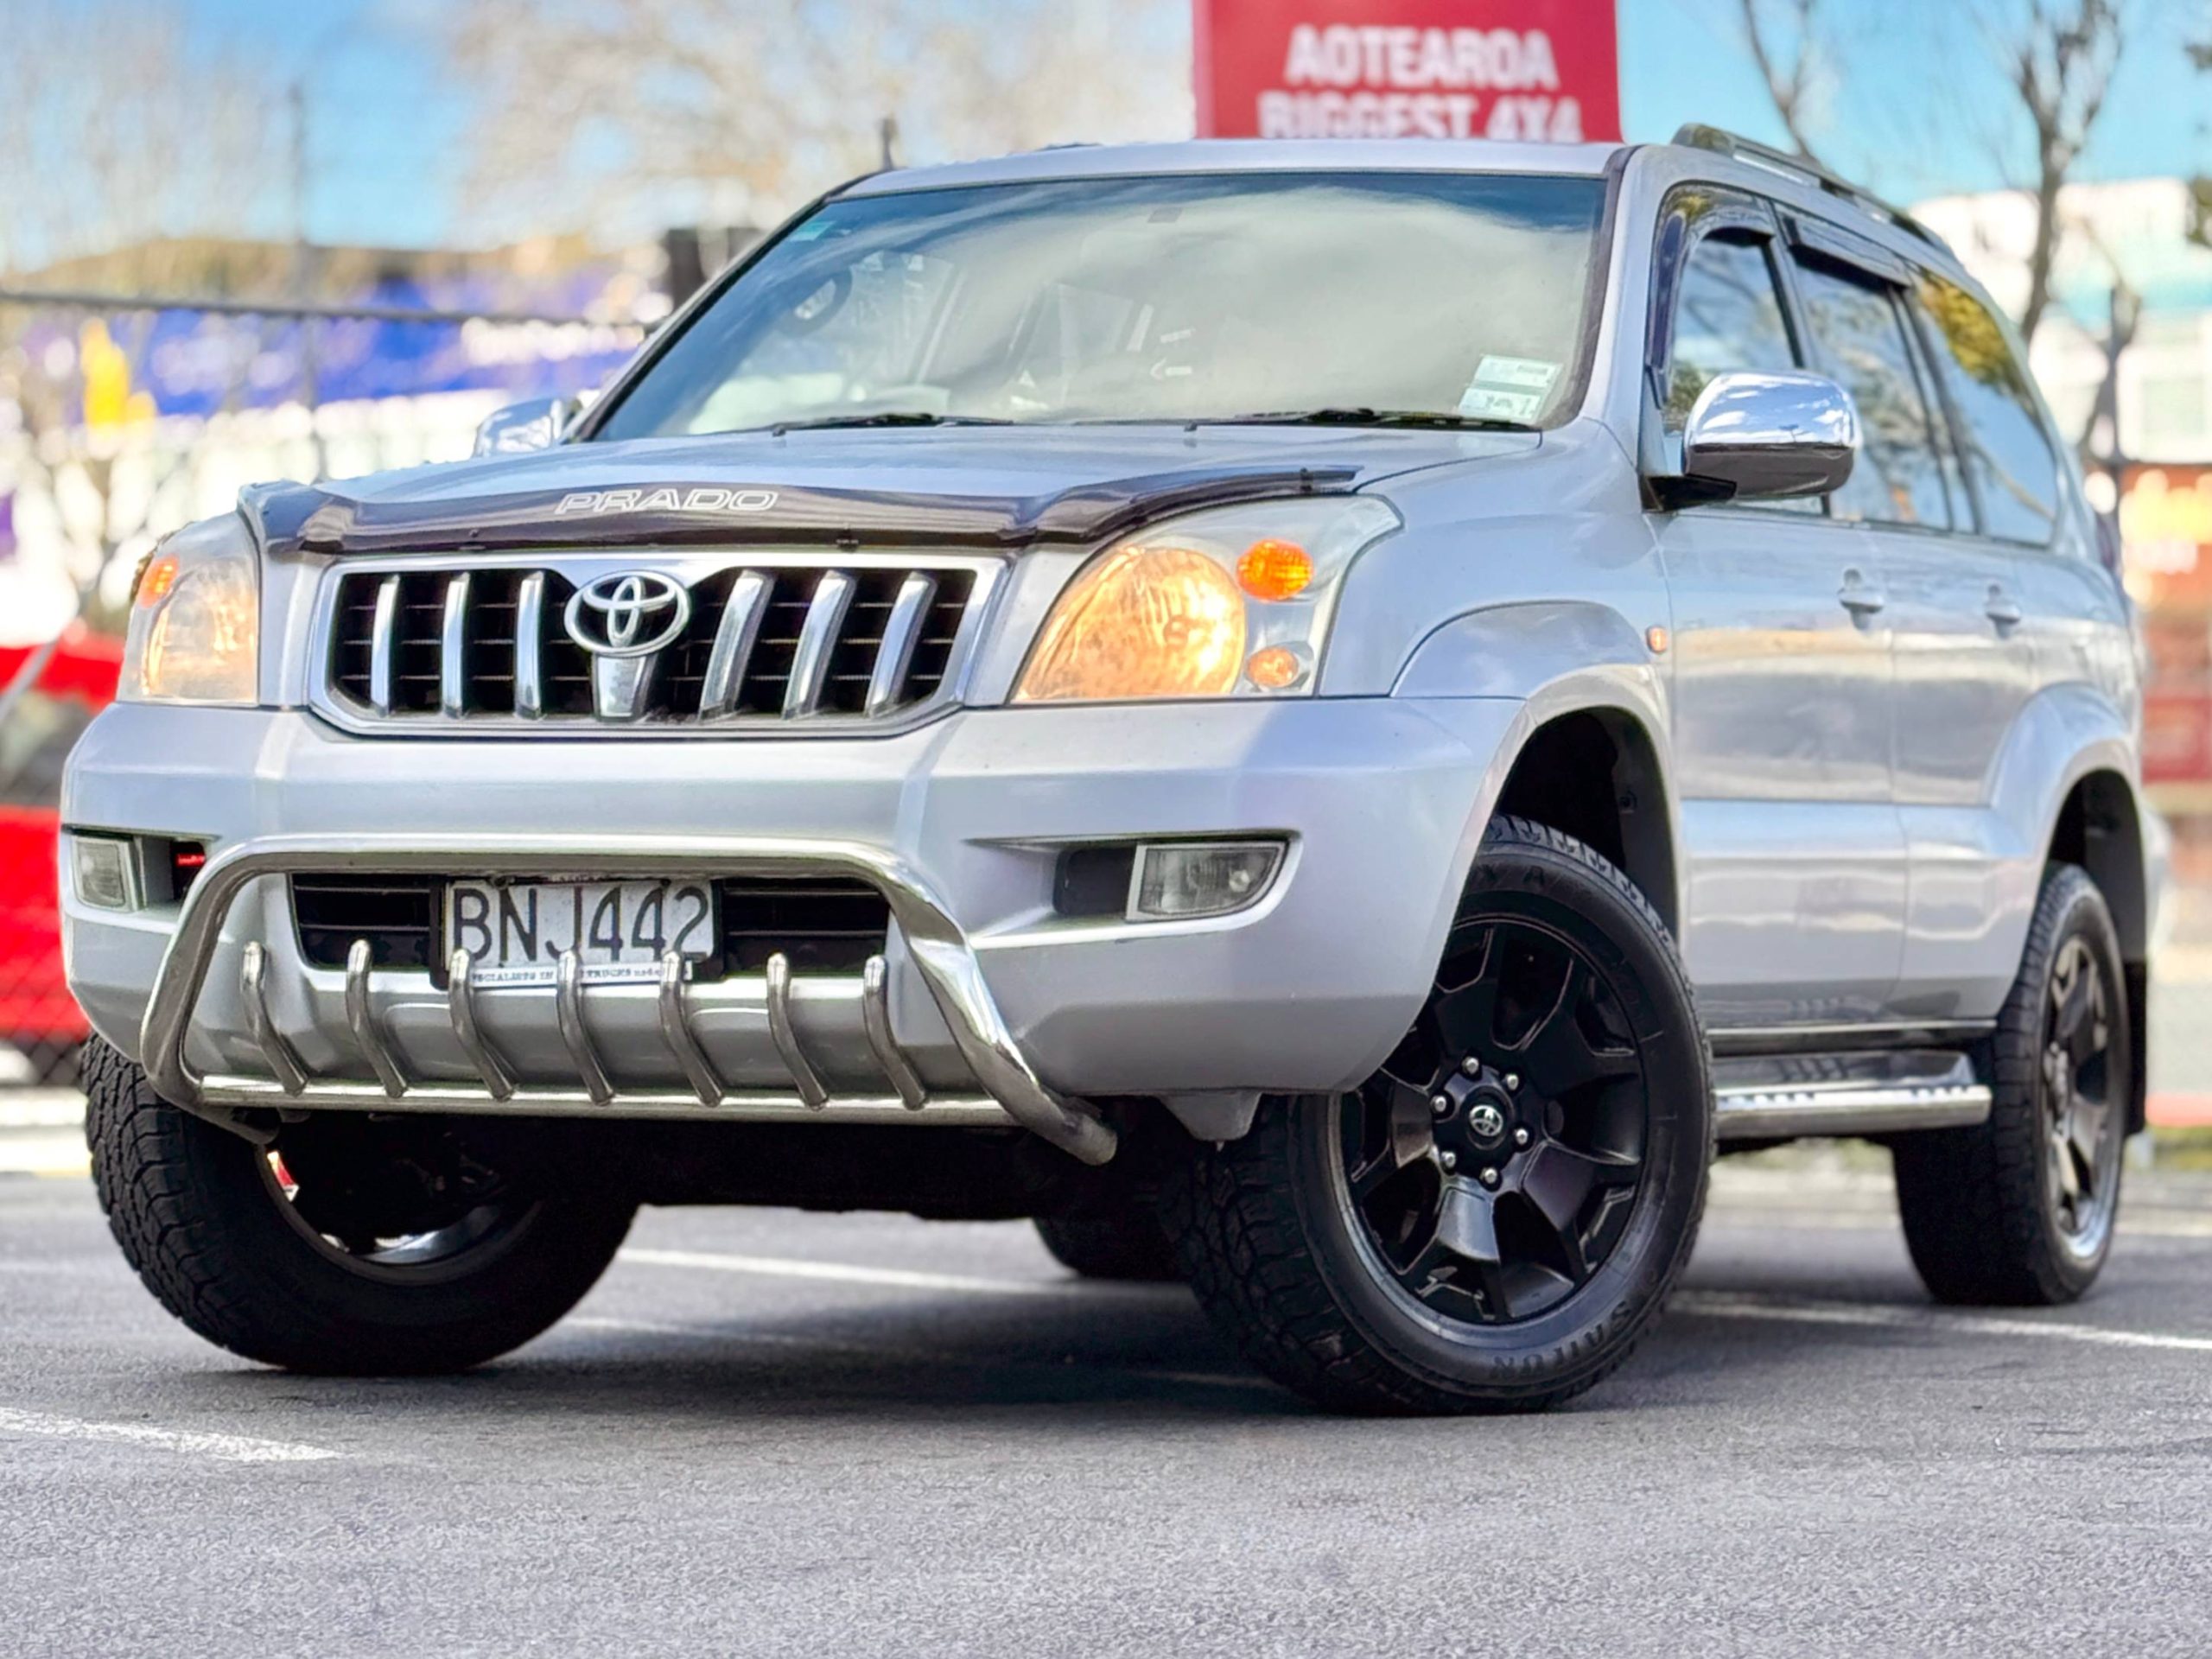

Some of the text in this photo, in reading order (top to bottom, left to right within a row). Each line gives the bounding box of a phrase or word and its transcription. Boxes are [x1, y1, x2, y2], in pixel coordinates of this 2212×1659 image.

[1285, 24, 1560, 89] AOTEAROA
[1257, 91, 1478, 139] BIGGEST
[554, 488, 778, 514] PRADO
[454, 886, 709, 963] BNJ442
